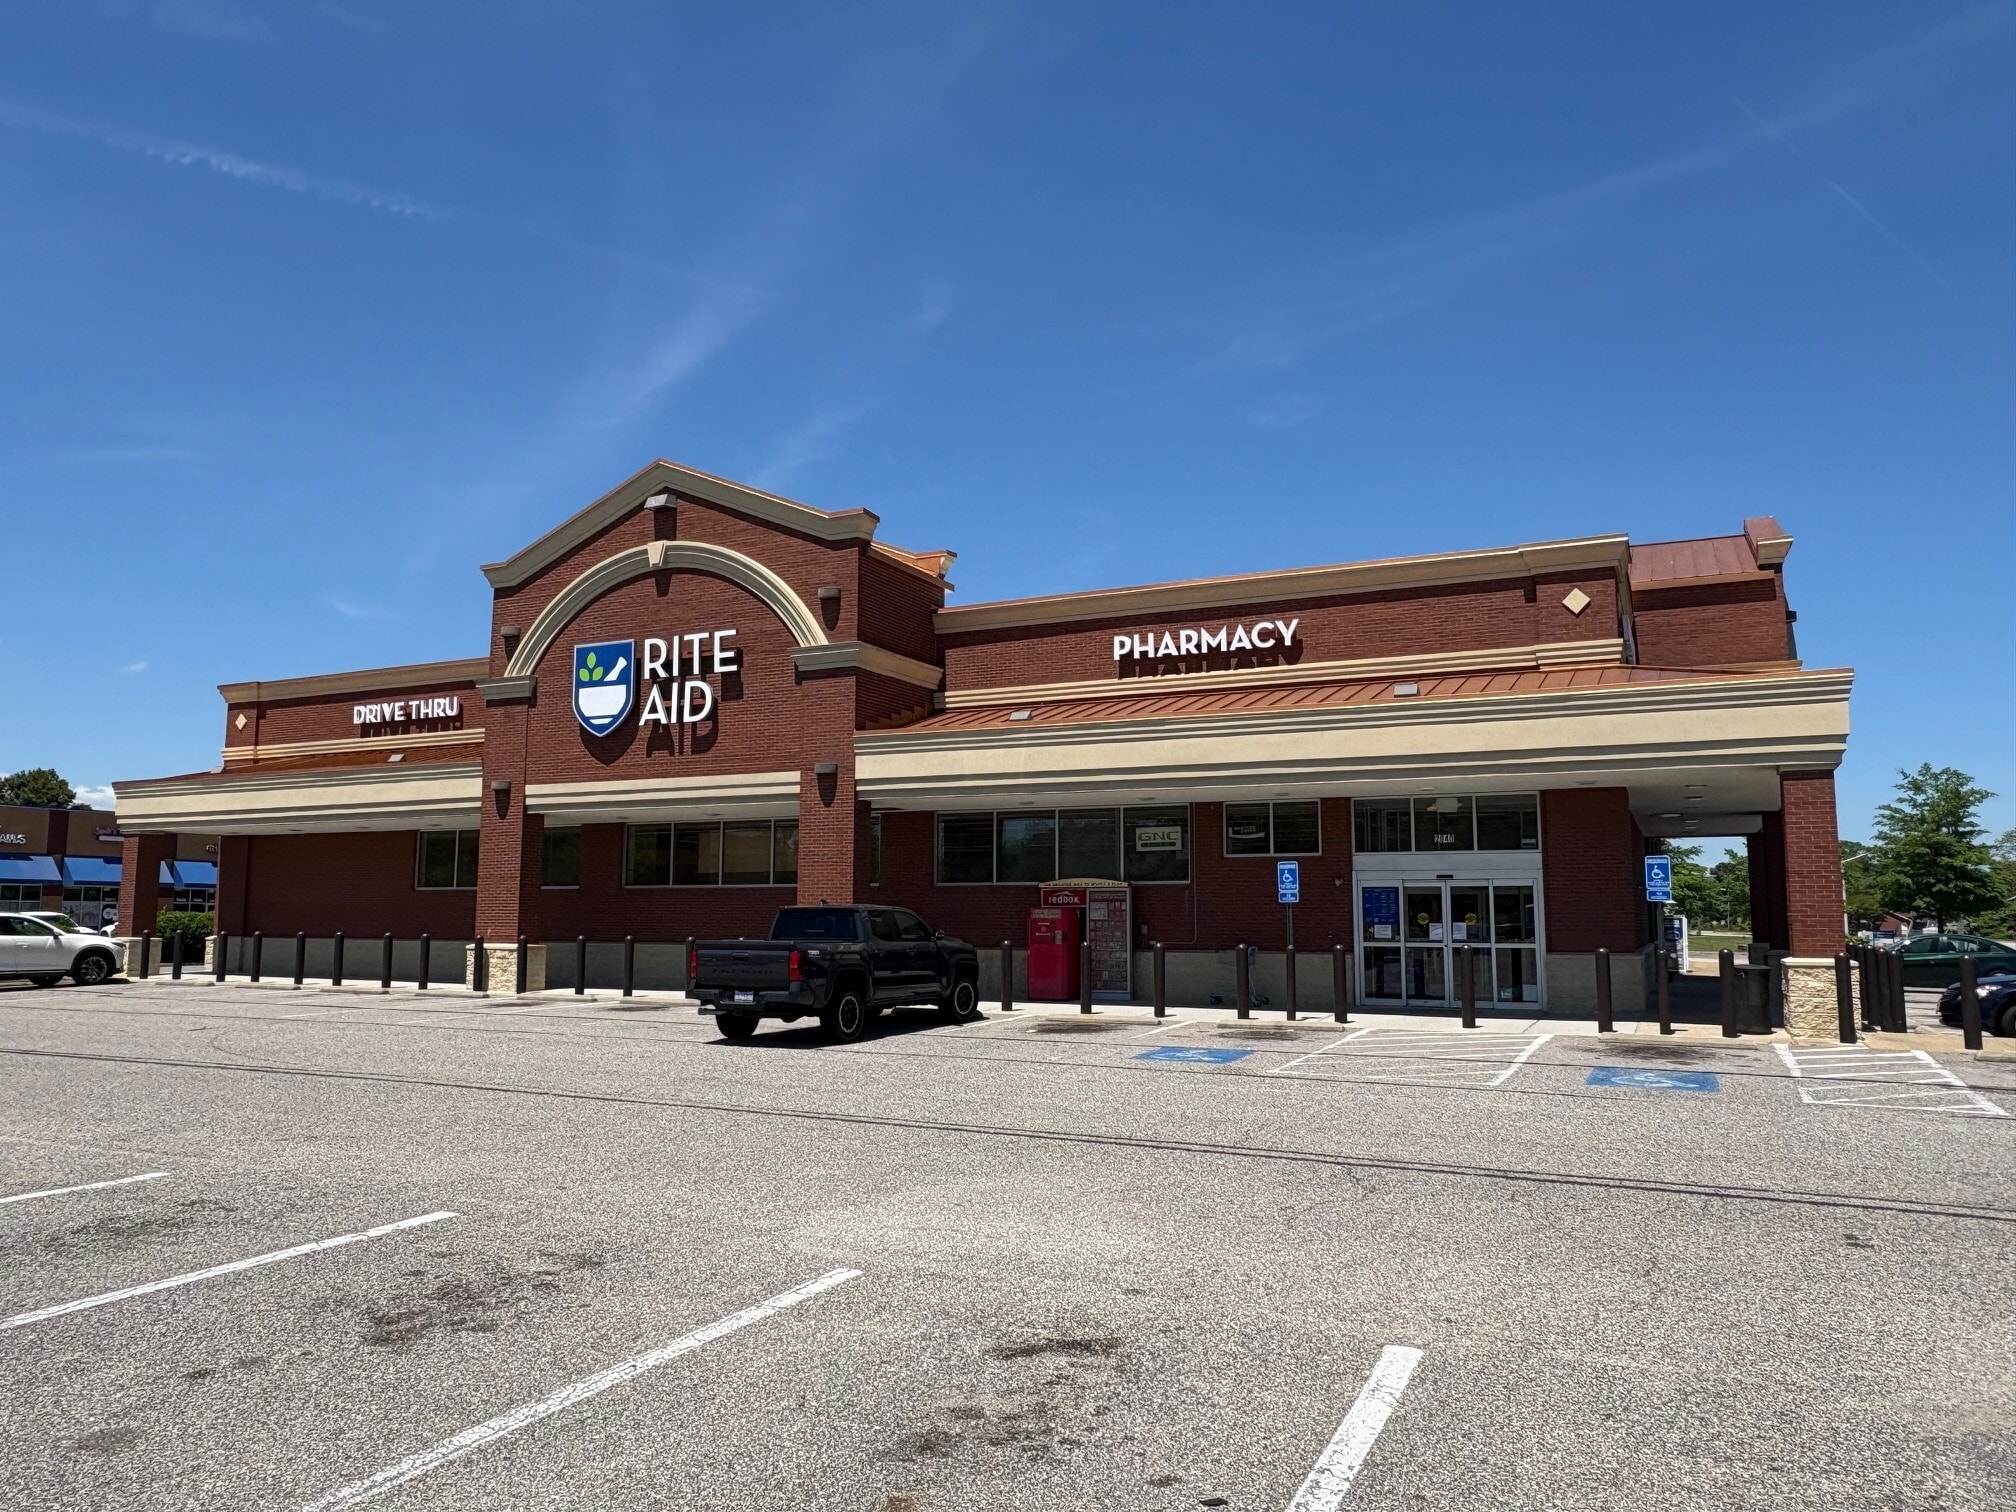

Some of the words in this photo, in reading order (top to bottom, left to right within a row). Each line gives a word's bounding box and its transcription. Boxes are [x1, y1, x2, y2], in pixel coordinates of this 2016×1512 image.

[644, 629, 738, 679] RITE
[1113, 618, 1299, 660] PHARMACY
[353, 702, 406, 724] DRIVE
[409, 696, 459, 719] THRU
[639, 681, 713, 726] AID
[1138, 831, 1180, 841] GNC
[1048, 894, 1080, 904] redbox
